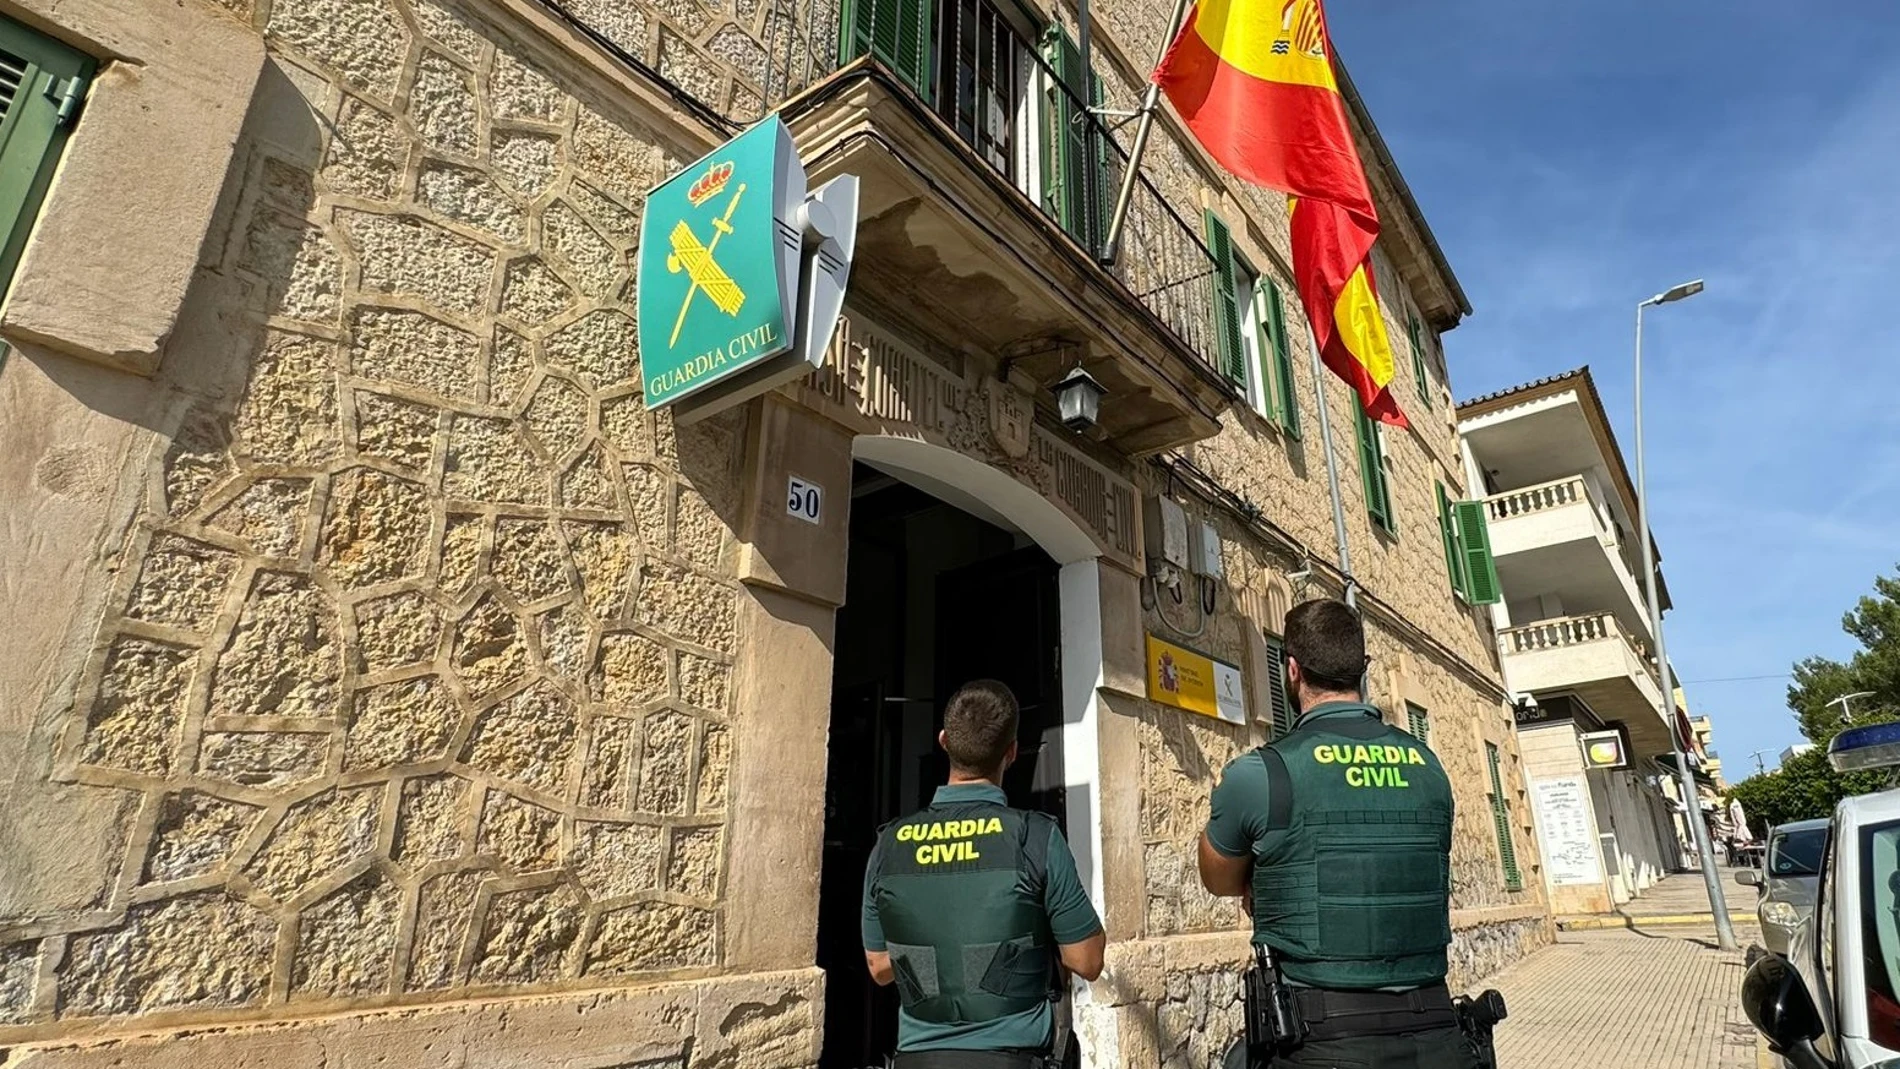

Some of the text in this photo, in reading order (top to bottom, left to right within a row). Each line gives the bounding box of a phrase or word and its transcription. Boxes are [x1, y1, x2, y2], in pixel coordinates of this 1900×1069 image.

[650, 323, 778, 396] GUARDIA CIVIL
[789, 481, 819, 519] 50
[1313, 745, 1425, 764] GUARDIA
[1346, 767, 1409, 787] CIVIL
[897, 818, 1002, 841] GUARDIA
[917, 842, 979, 864] CIVIL
